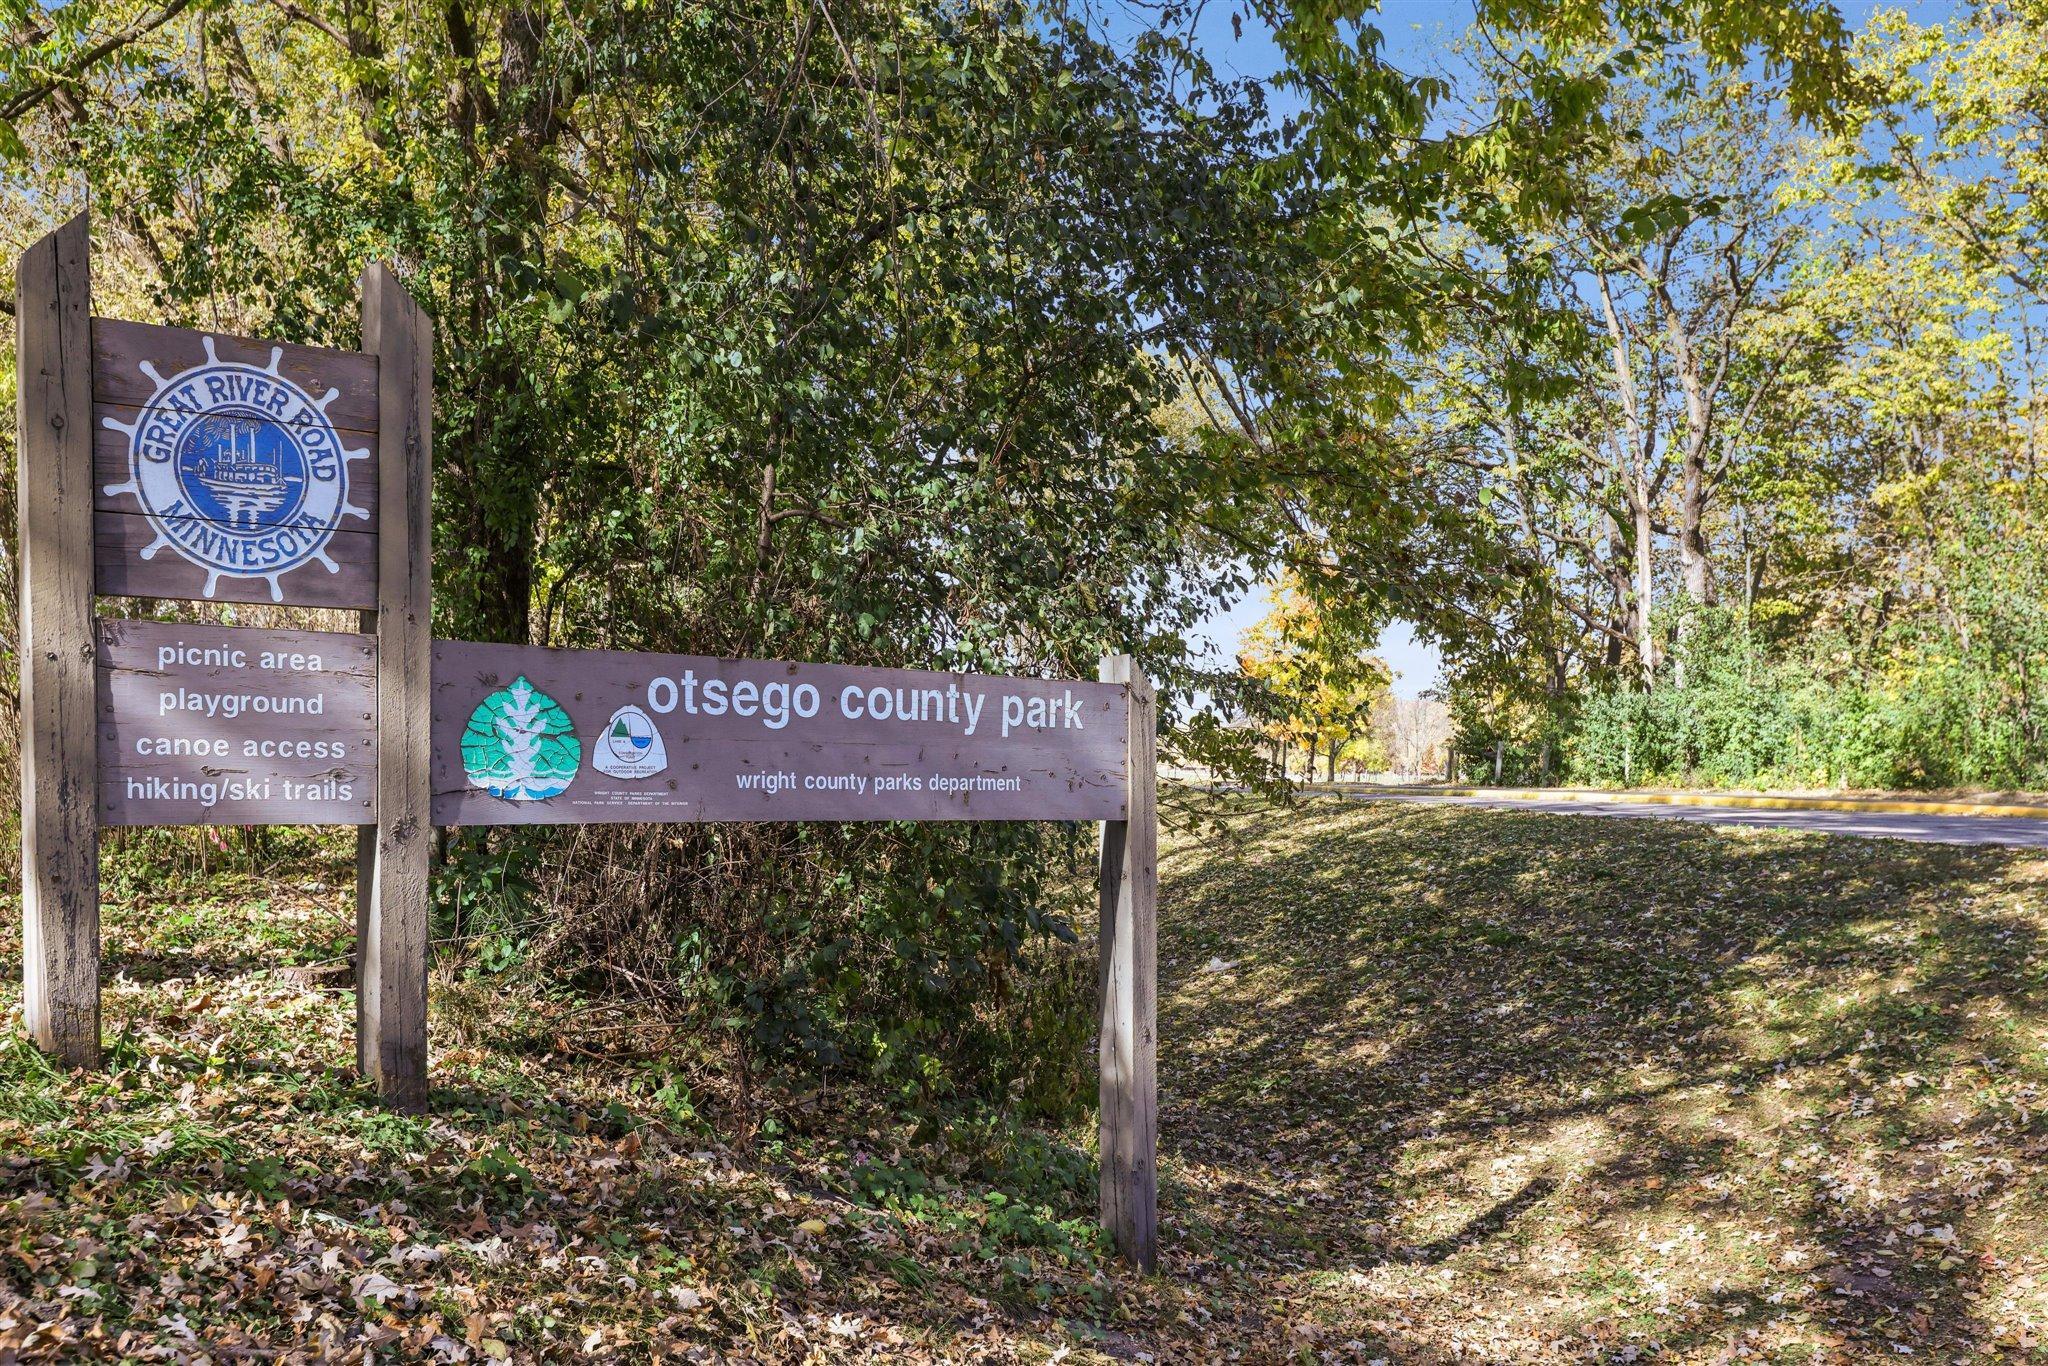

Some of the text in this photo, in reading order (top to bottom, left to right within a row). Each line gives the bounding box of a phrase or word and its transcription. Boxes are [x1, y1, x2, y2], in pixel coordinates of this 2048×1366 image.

[141, 375, 337, 482] GREAT RIVER ROAD
[159, 500, 326, 566] MINNESOTA
[158, 642, 323, 672] picnic area
[159, 688, 323, 719] playground
[647, 669, 1085, 738] otsego county park
[136, 737, 346, 759] canoe access
[127, 777, 353, 807] hiking/ski trails
[736, 770, 1022, 796] wright county parks department
